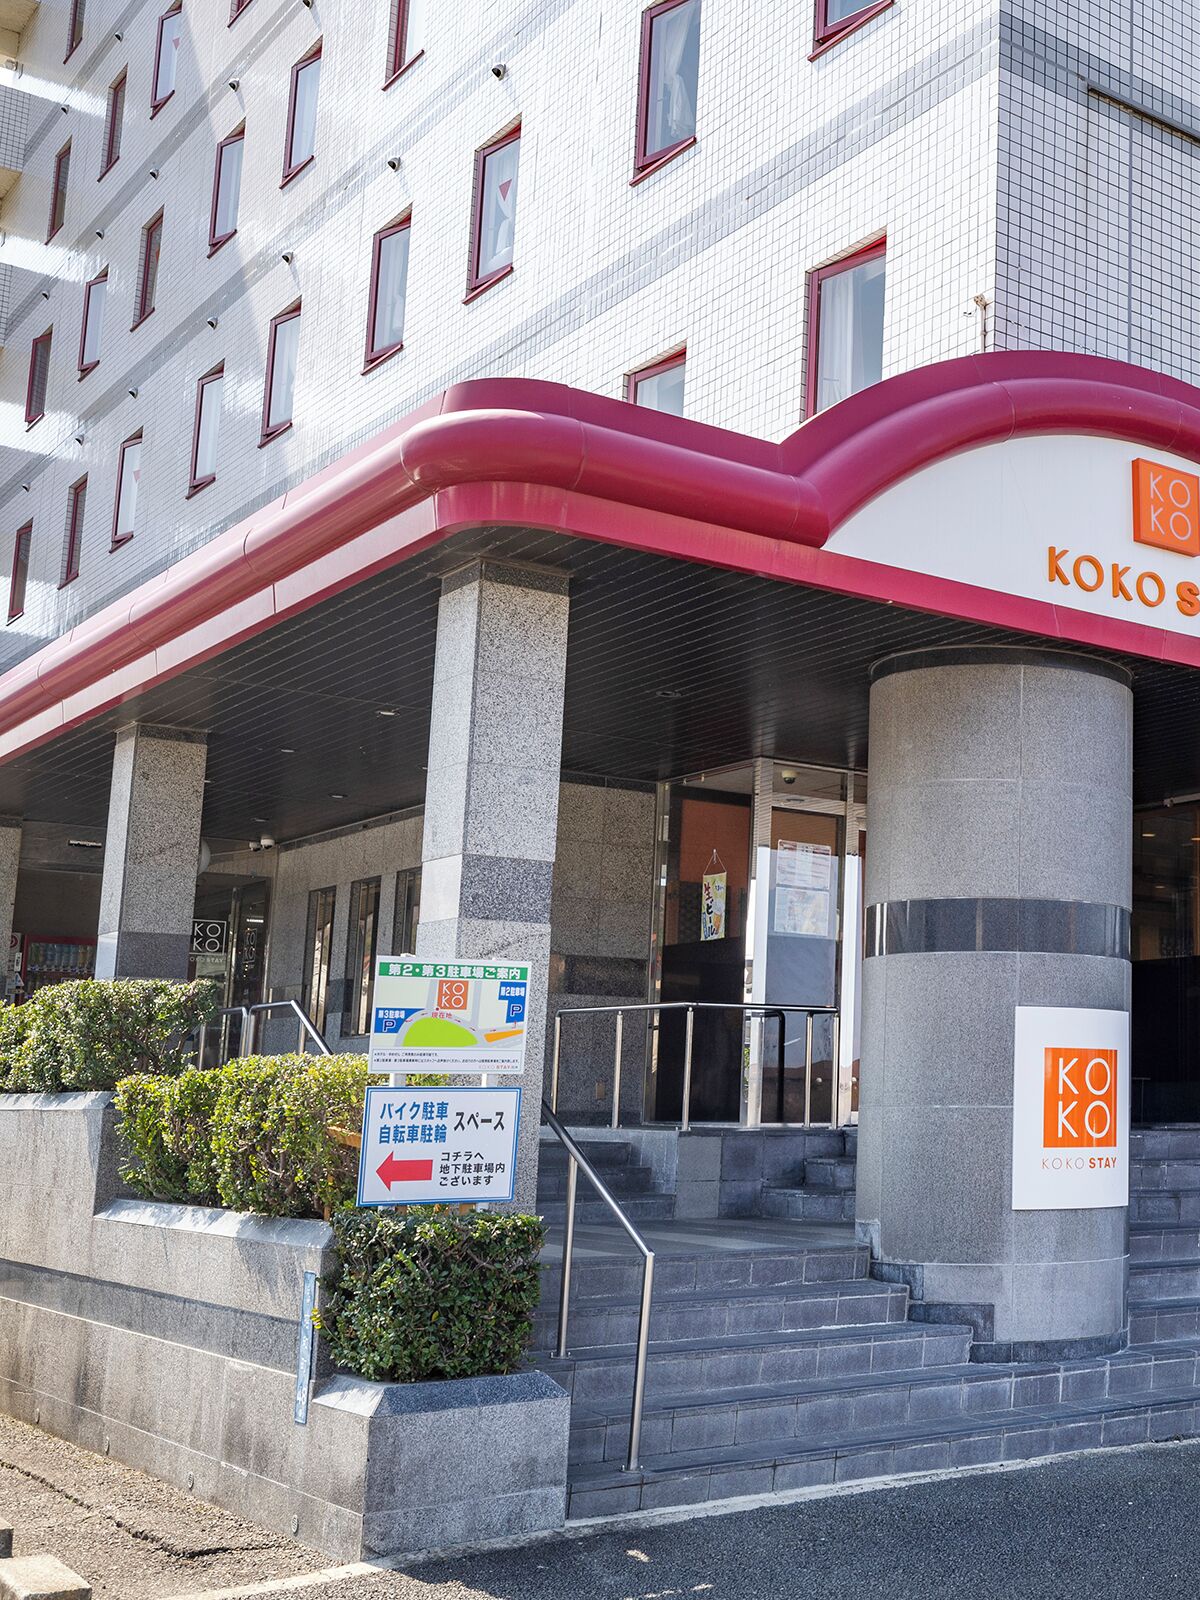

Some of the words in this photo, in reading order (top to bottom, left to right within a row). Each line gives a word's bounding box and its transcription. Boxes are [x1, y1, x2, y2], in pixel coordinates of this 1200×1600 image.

[1149, 471, 1191, 509] KO
[1150, 503, 1192, 541] KO
[1048, 546, 1166, 607] KOKO
[194, 922, 221, 937] KO
[192, 938, 220, 952] KO
[389, 964, 521, 979] 第2・第3駐車場ご案内
[442, 982, 465, 995] KO
[441, 995, 464, 1008] KO
[510, 1004, 522, 1017] P
[382, 1020, 395, 1032] P
[1058, 1057, 1111, 1096] KO
[380, 1101, 449, 1121] バイク駐車
[454, 1111, 505, 1131] スペース
[1057, 1100, 1111, 1139] KO
[379, 1124, 447, 1144] 自転車駐輪
[441, 1151, 484, 1161] コチラへ
[1041, 1157, 1085, 1170] KOKO
[1088, 1157, 1118, 1169] STAY
[439, 1163, 505, 1174] 地下駐車場内
[439, 1175, 494, 1187] ございます
